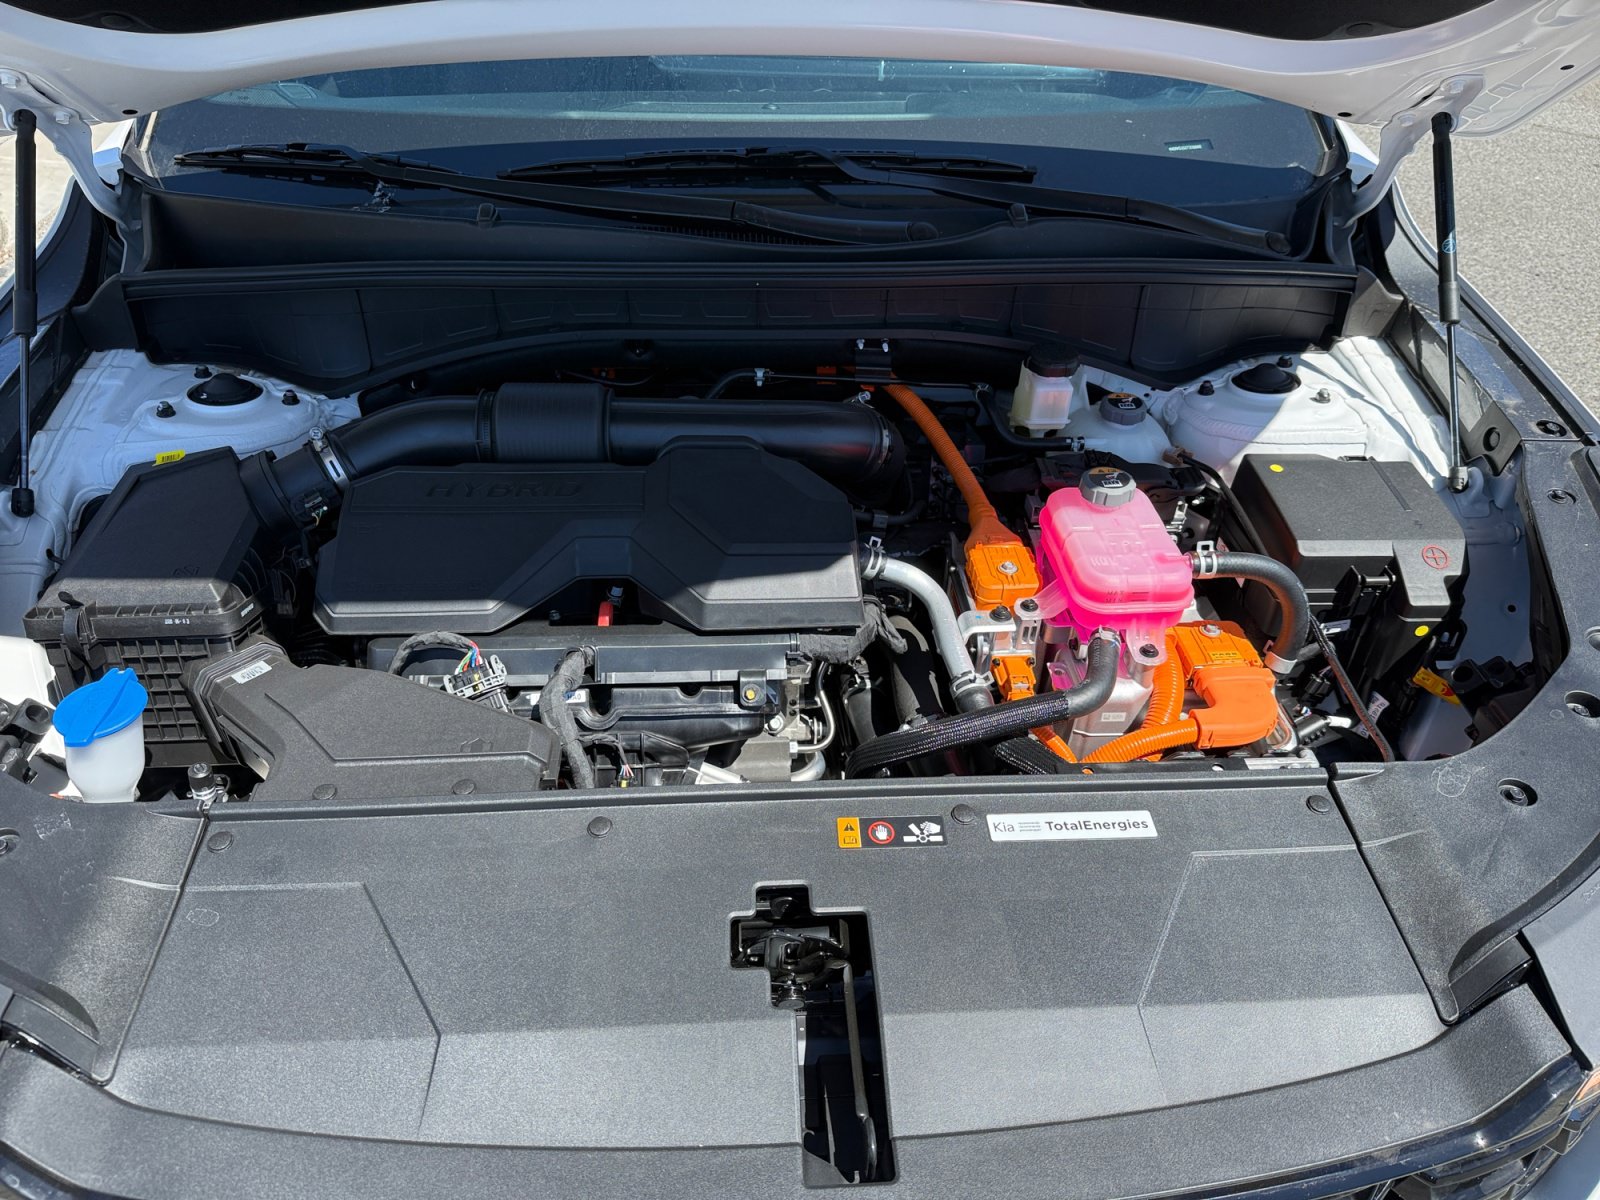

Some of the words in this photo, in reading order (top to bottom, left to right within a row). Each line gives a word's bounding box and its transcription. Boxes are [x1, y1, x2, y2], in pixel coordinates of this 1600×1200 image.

[426, 480, 585, 498] HYBRID
[992, 821, 1016, 833] Kia
[1044, 818, 1149, 832] TotalEnergies
